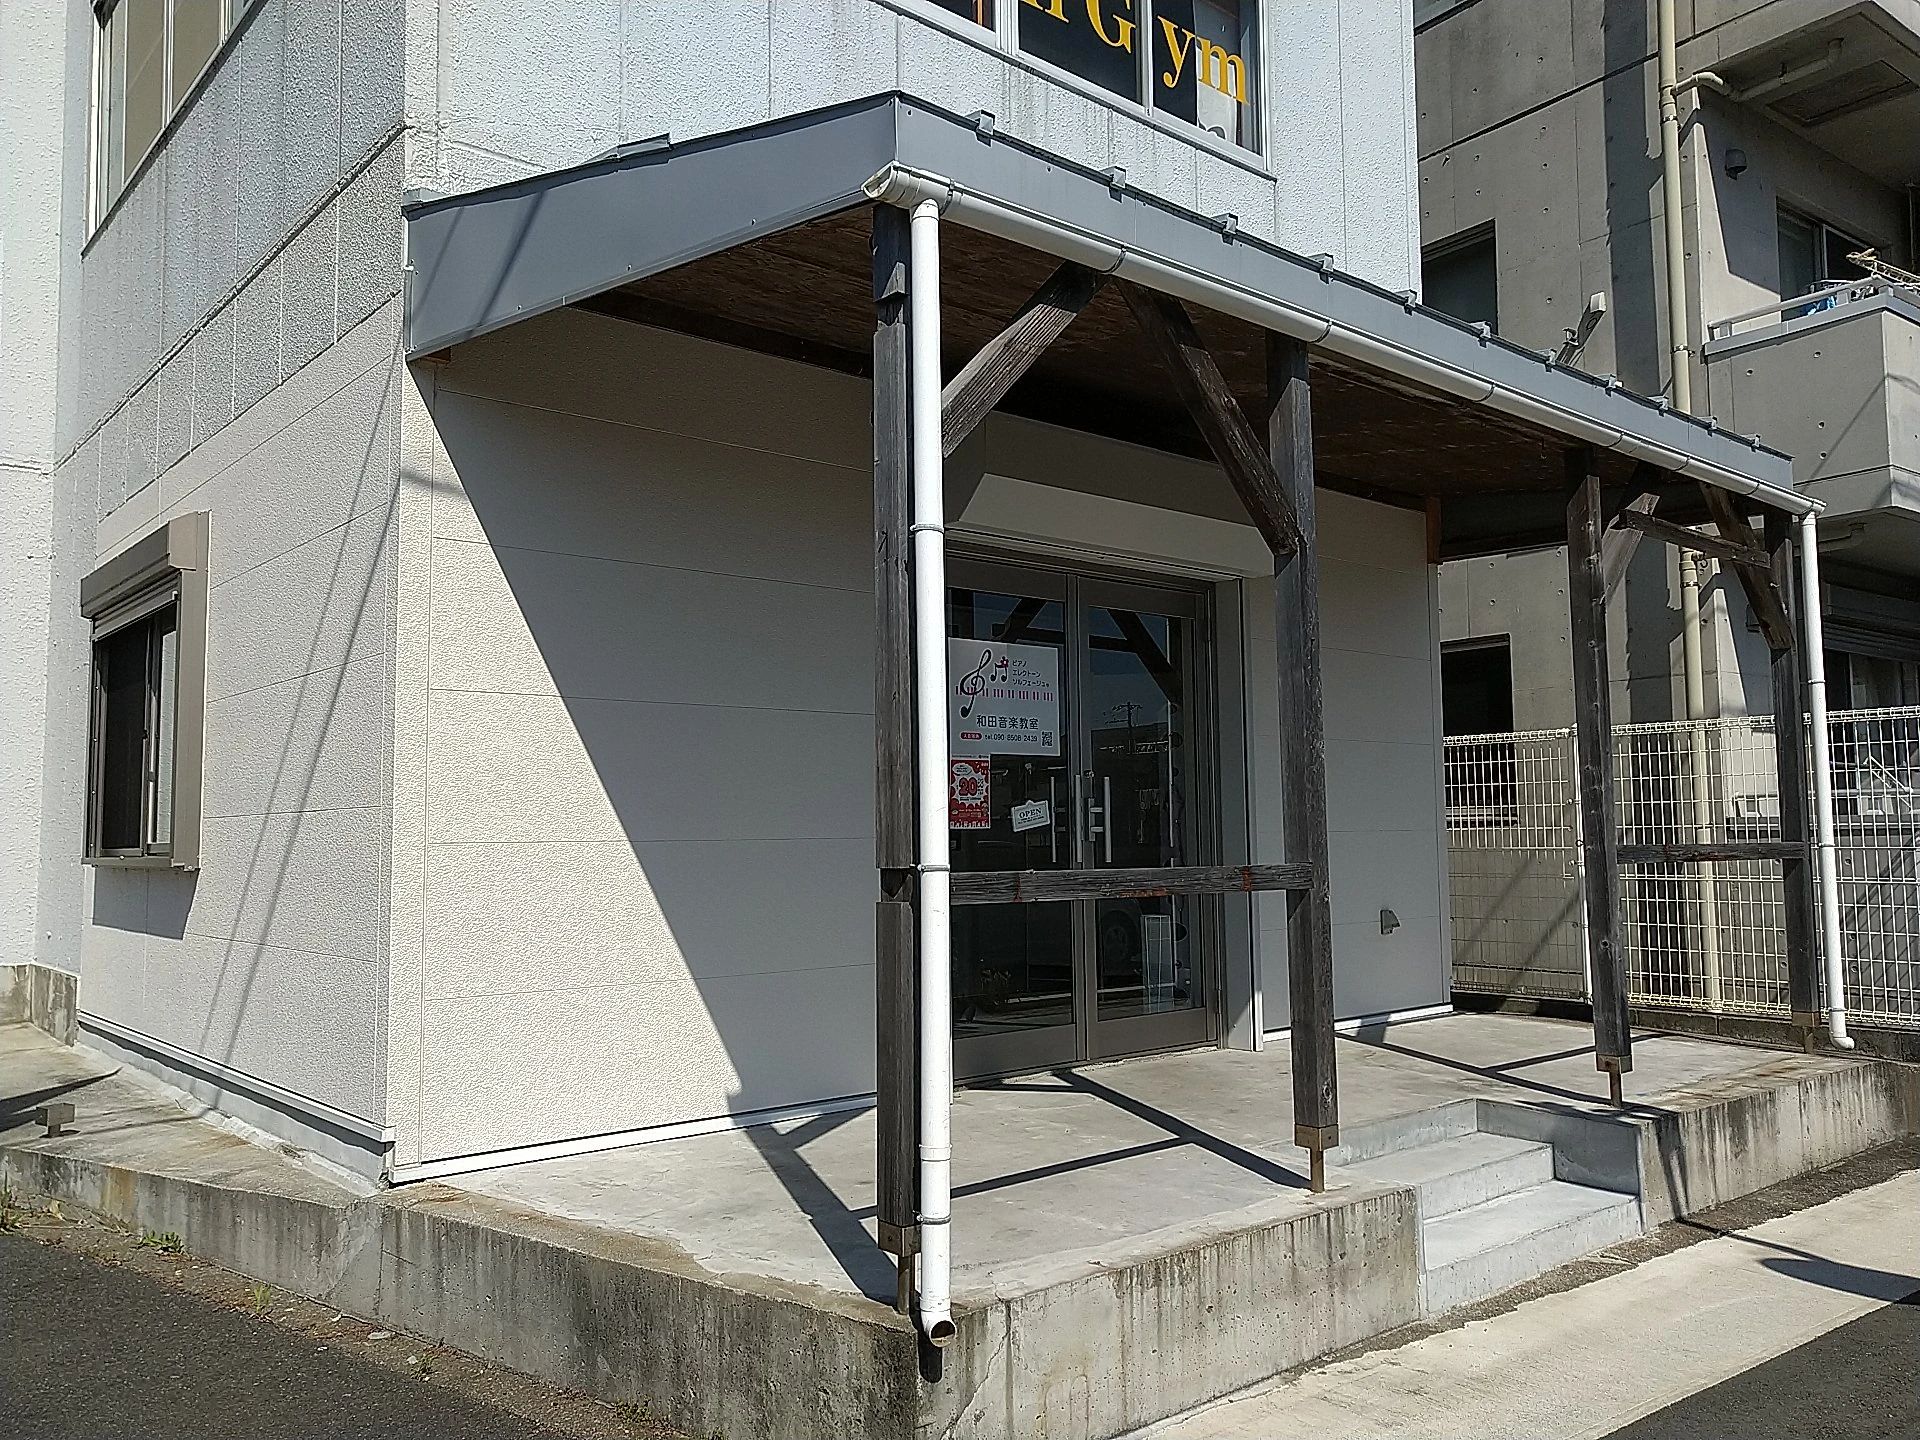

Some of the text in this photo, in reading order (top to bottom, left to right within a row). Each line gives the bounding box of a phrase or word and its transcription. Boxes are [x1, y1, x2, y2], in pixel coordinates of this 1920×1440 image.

[1012, 660, 1027, 668] ピアノ
[1012, 669, 1041, 678] エレクトーン
[976, 715, 1039, 730] 和田音楽教室
[1019, 807, 1042, 819] OPEN
